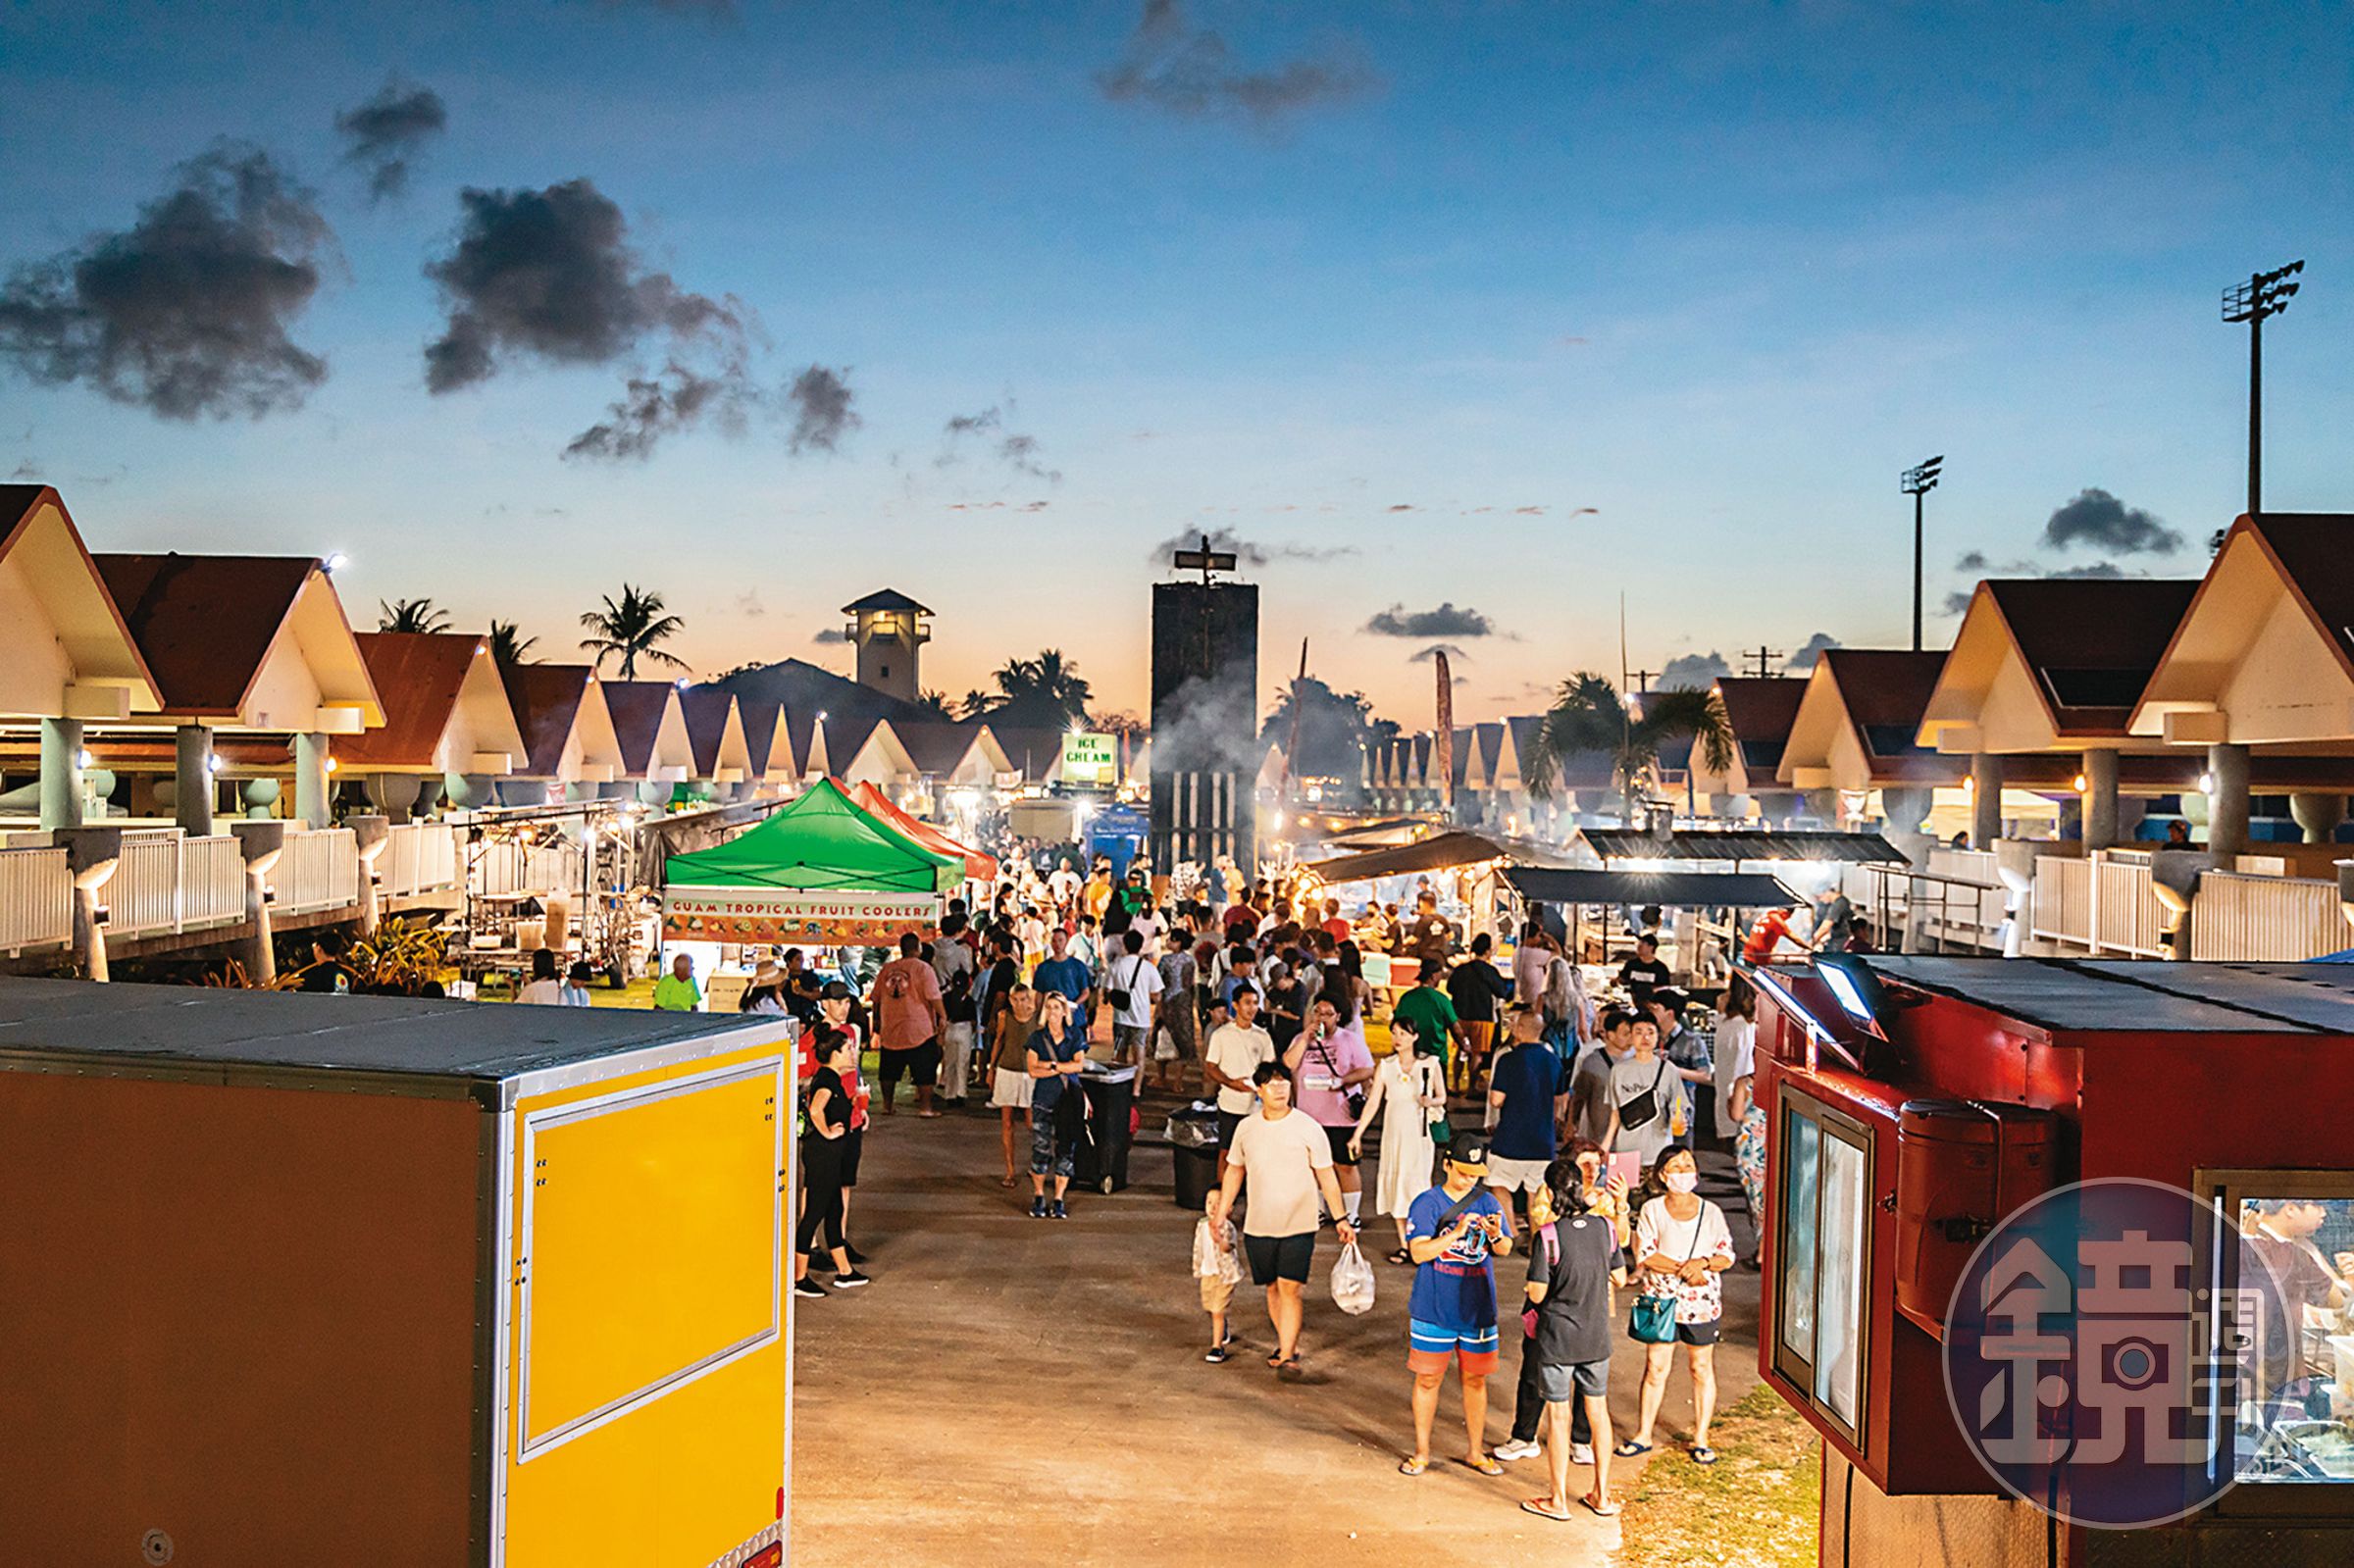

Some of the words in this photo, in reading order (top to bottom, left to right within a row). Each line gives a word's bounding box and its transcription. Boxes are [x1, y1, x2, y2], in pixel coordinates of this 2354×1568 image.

[1078, 738, 1099, 748] ICE
[1066, 751, 1111, 763] CREAM
[673, 901, 717, 912] GUAM
[726, 903, 801, 914] TROPICAL
[810, 905, 854, 915] FRUIT
[862, 906, 931, 917] COOLERS
